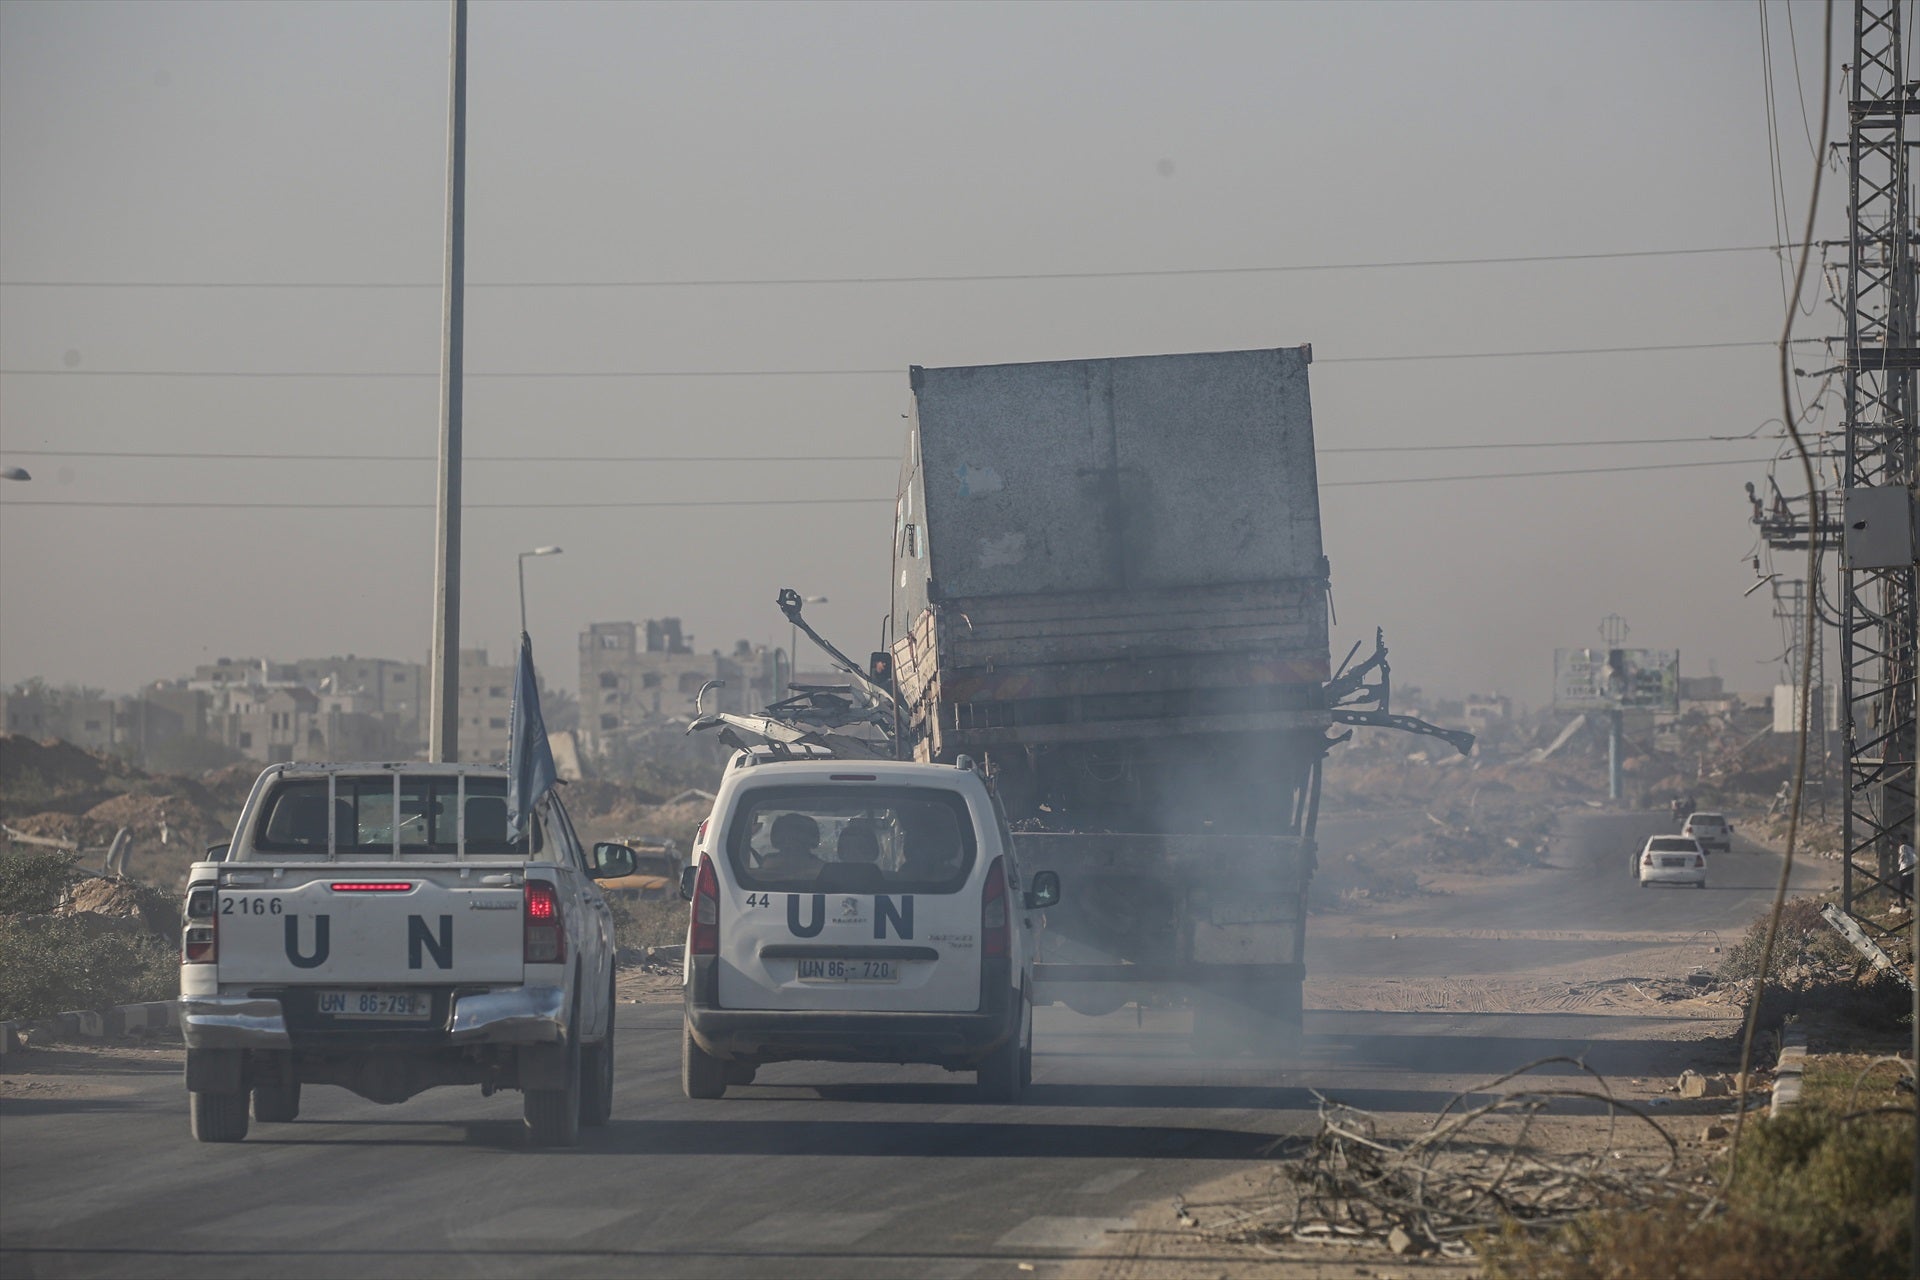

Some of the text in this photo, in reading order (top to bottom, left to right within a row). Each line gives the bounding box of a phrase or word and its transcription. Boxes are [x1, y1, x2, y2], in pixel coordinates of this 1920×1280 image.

[221, 897, 283, 916] 2166
[746, 893, 770, 908] 44
[802, 961, 825, 977] UN
[320, 993, 345, 1012] UN
